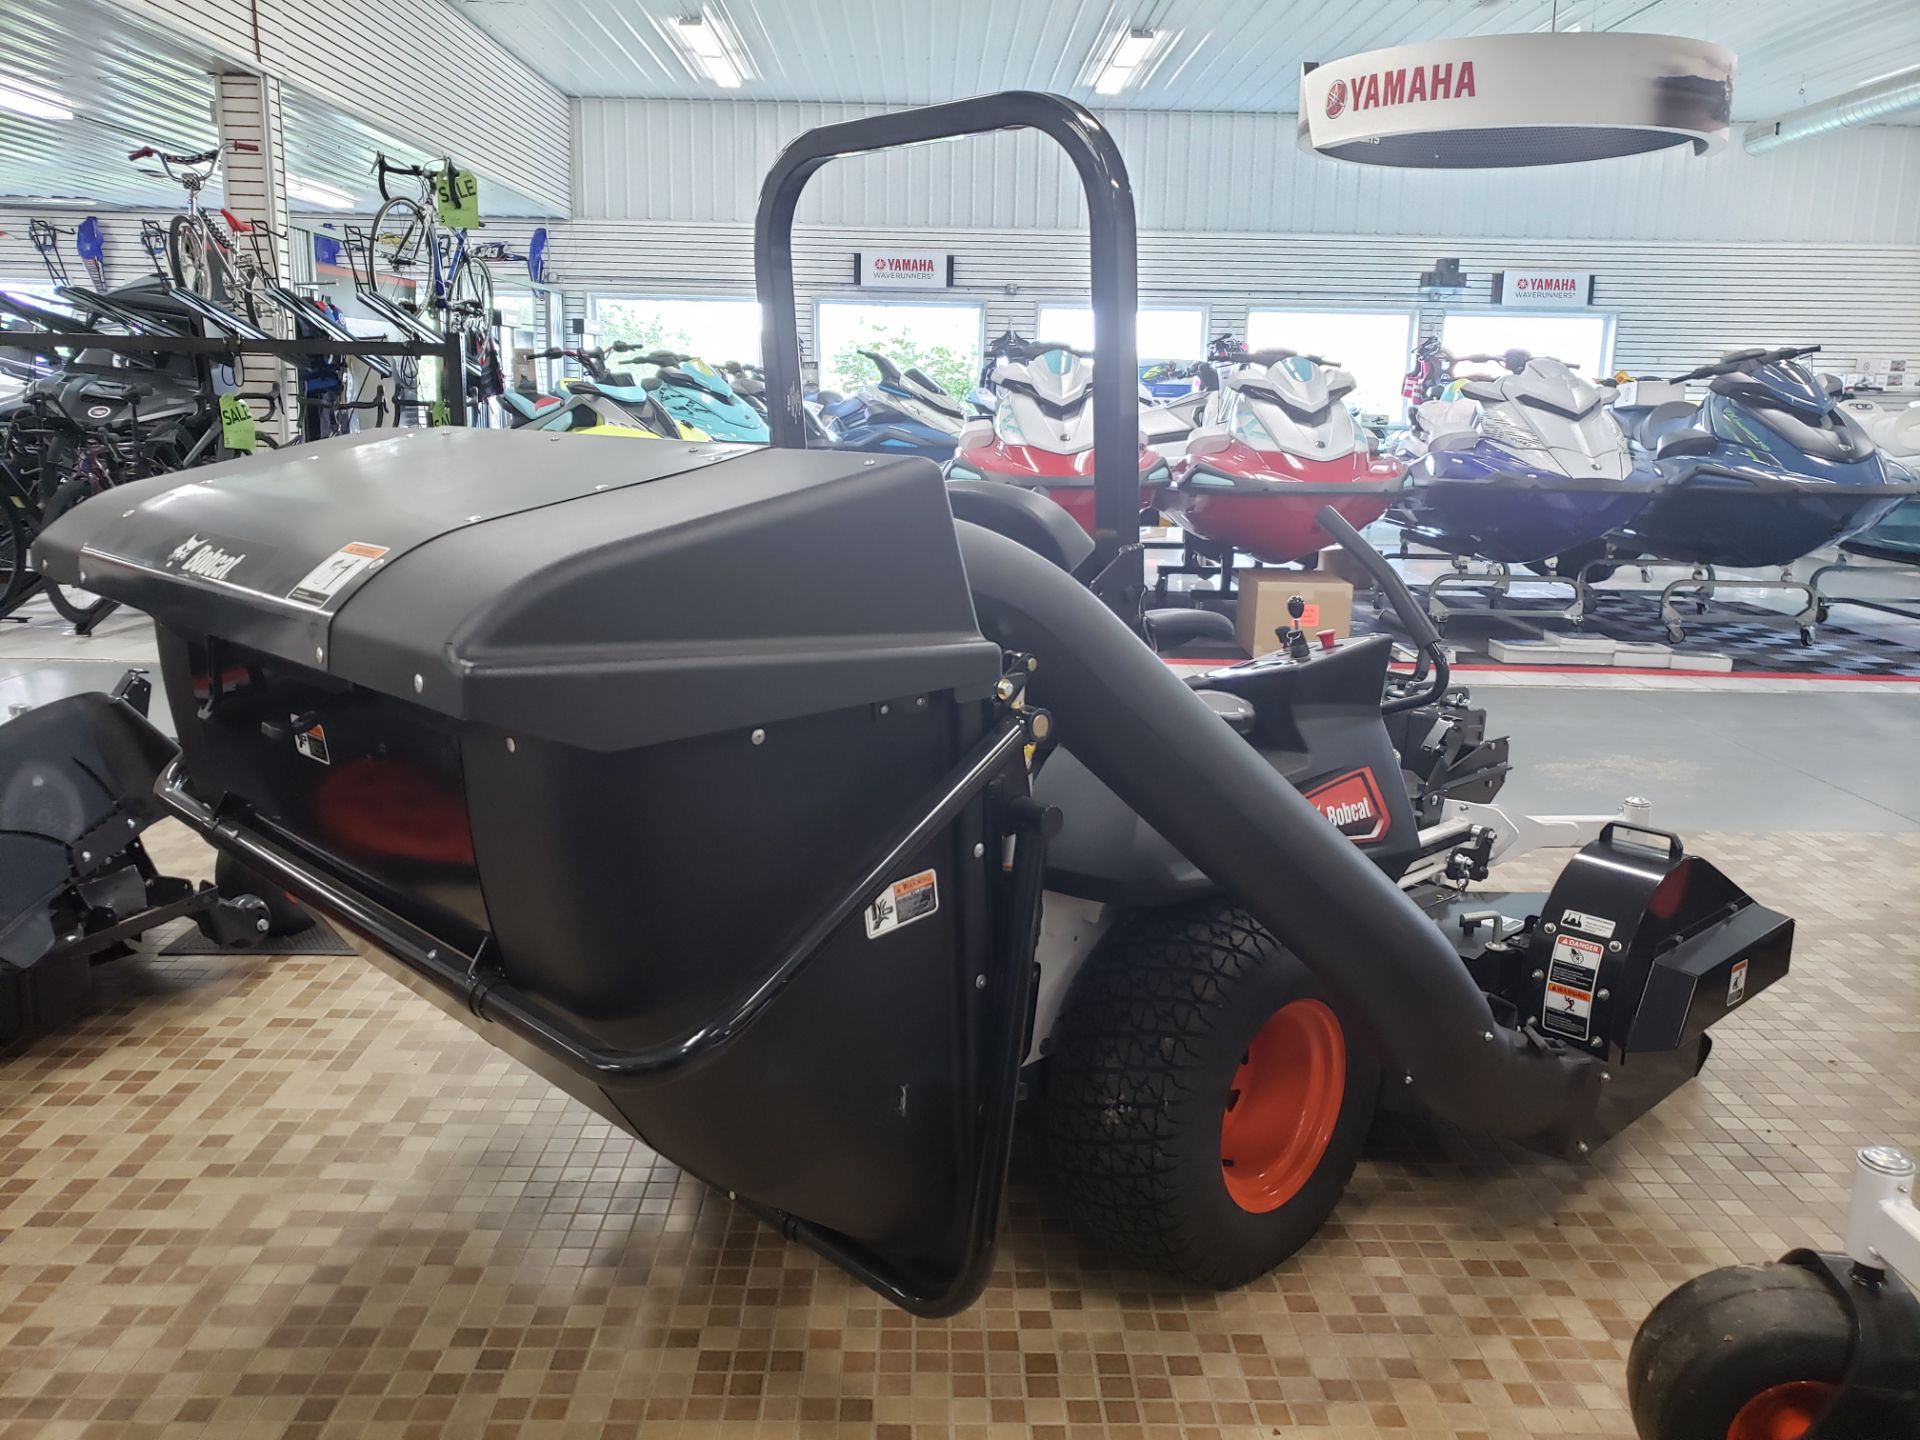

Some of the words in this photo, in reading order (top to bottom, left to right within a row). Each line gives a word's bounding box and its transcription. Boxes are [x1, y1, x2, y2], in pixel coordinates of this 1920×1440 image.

[1351, 61, 1476, 112] YAMAHA
[439, 180, 476, 203] SLE
[887, 258, 934, 271] YAMAHA
[1530, 278, 1576, 291] YAMAHA
[222, 404, 252, 426] SALE
[181, 544, 246, 580] Bobcat
[1326, 797, 1372, 827] Bobcat
[1569, 939, 1599, 953] DANGER
